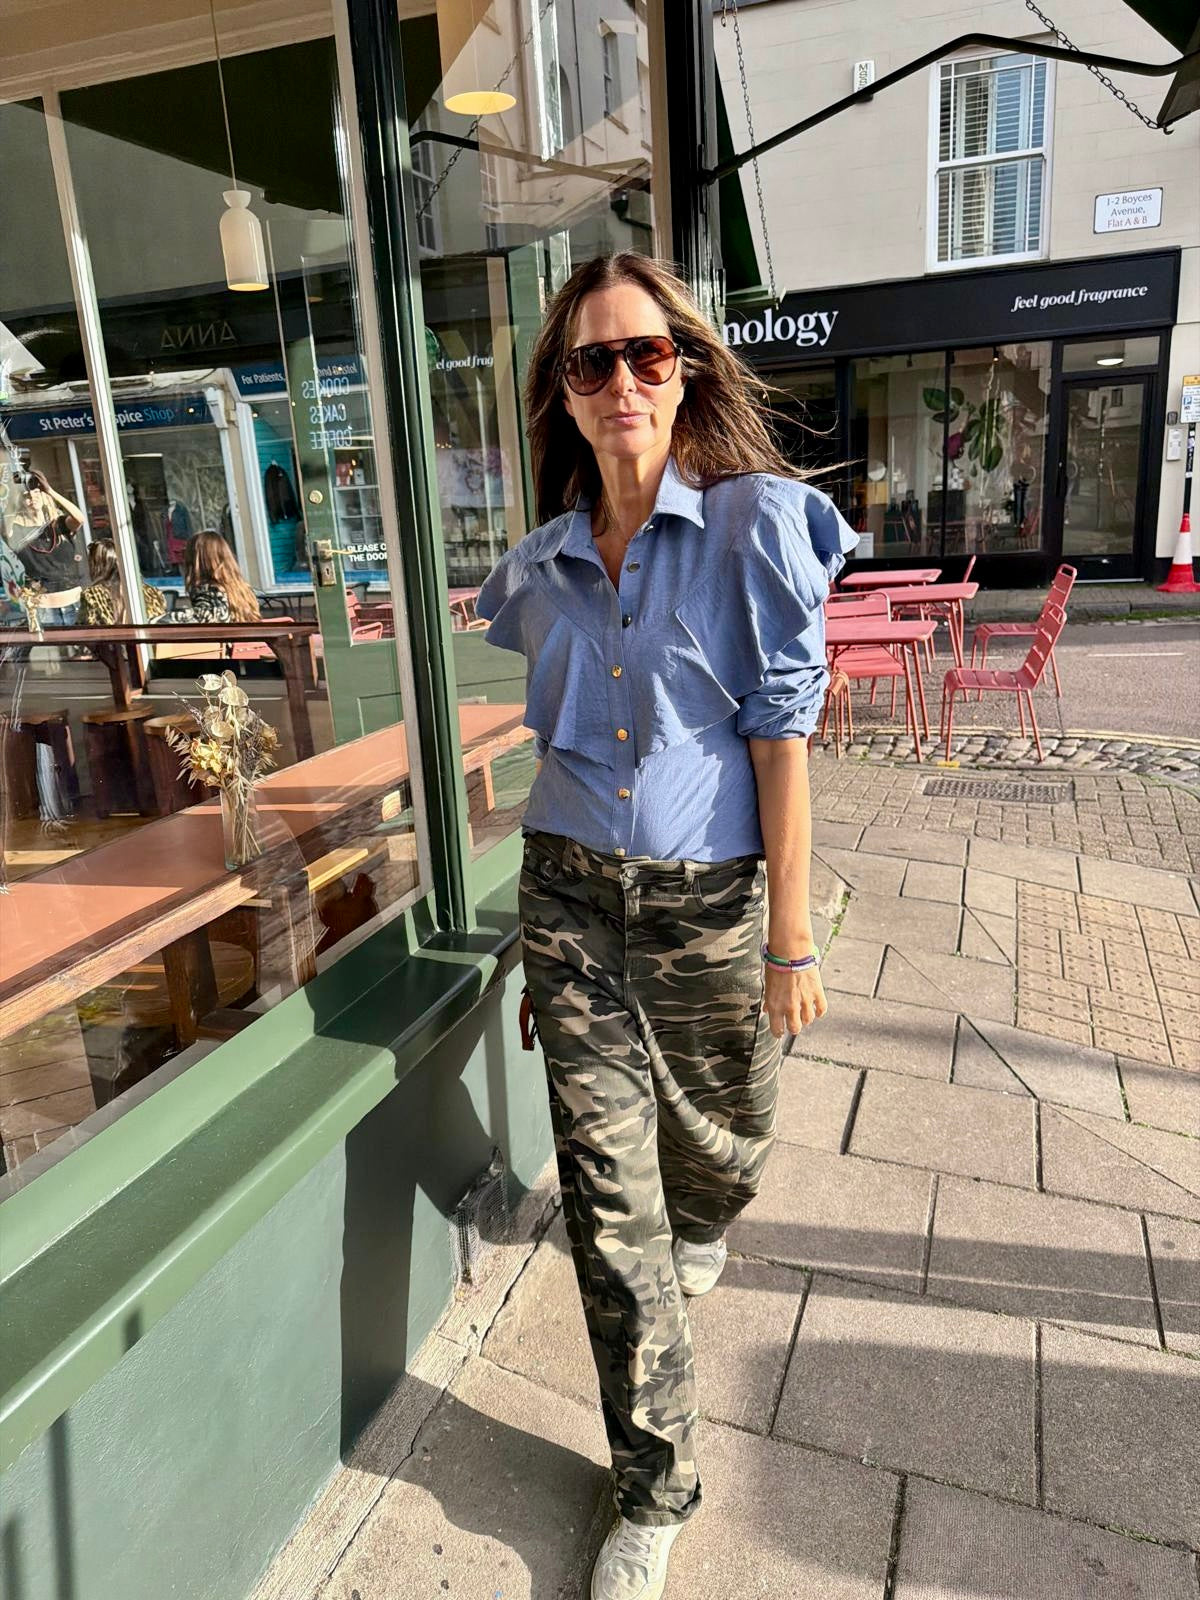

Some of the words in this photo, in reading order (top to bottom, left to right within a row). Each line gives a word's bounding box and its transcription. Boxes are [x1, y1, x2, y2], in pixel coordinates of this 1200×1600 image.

[1106, 196, 1120, 206] 1-2
[1122, 193, 1153, 205] Boyces
[1110, 206, 1146, 217] Avenue,
[1107, 219, 1124, 229] Flat
[1124, 217, 1132, 226] A
[1133, 217, 1141, 225] &
[1011, 295, 1038, 313] feel
[1040, 290, 1075, 309] good
[1076, 286, 1149, 306] fragrance
[723, 308, 839, 347] nology
[446, 356, 471, 371] good
[470, 355, 494, 369] frag
[241, 375, 254, 385] For
[39, 416, 54, 431] St
[53, 412, 95, 430] Peter's
[115, 410, 144, 427] spice
[144, 407, 175, 421] Shop
[347, 543, 380, 553] PLEASE
[348, 553, 366, 562] THE
